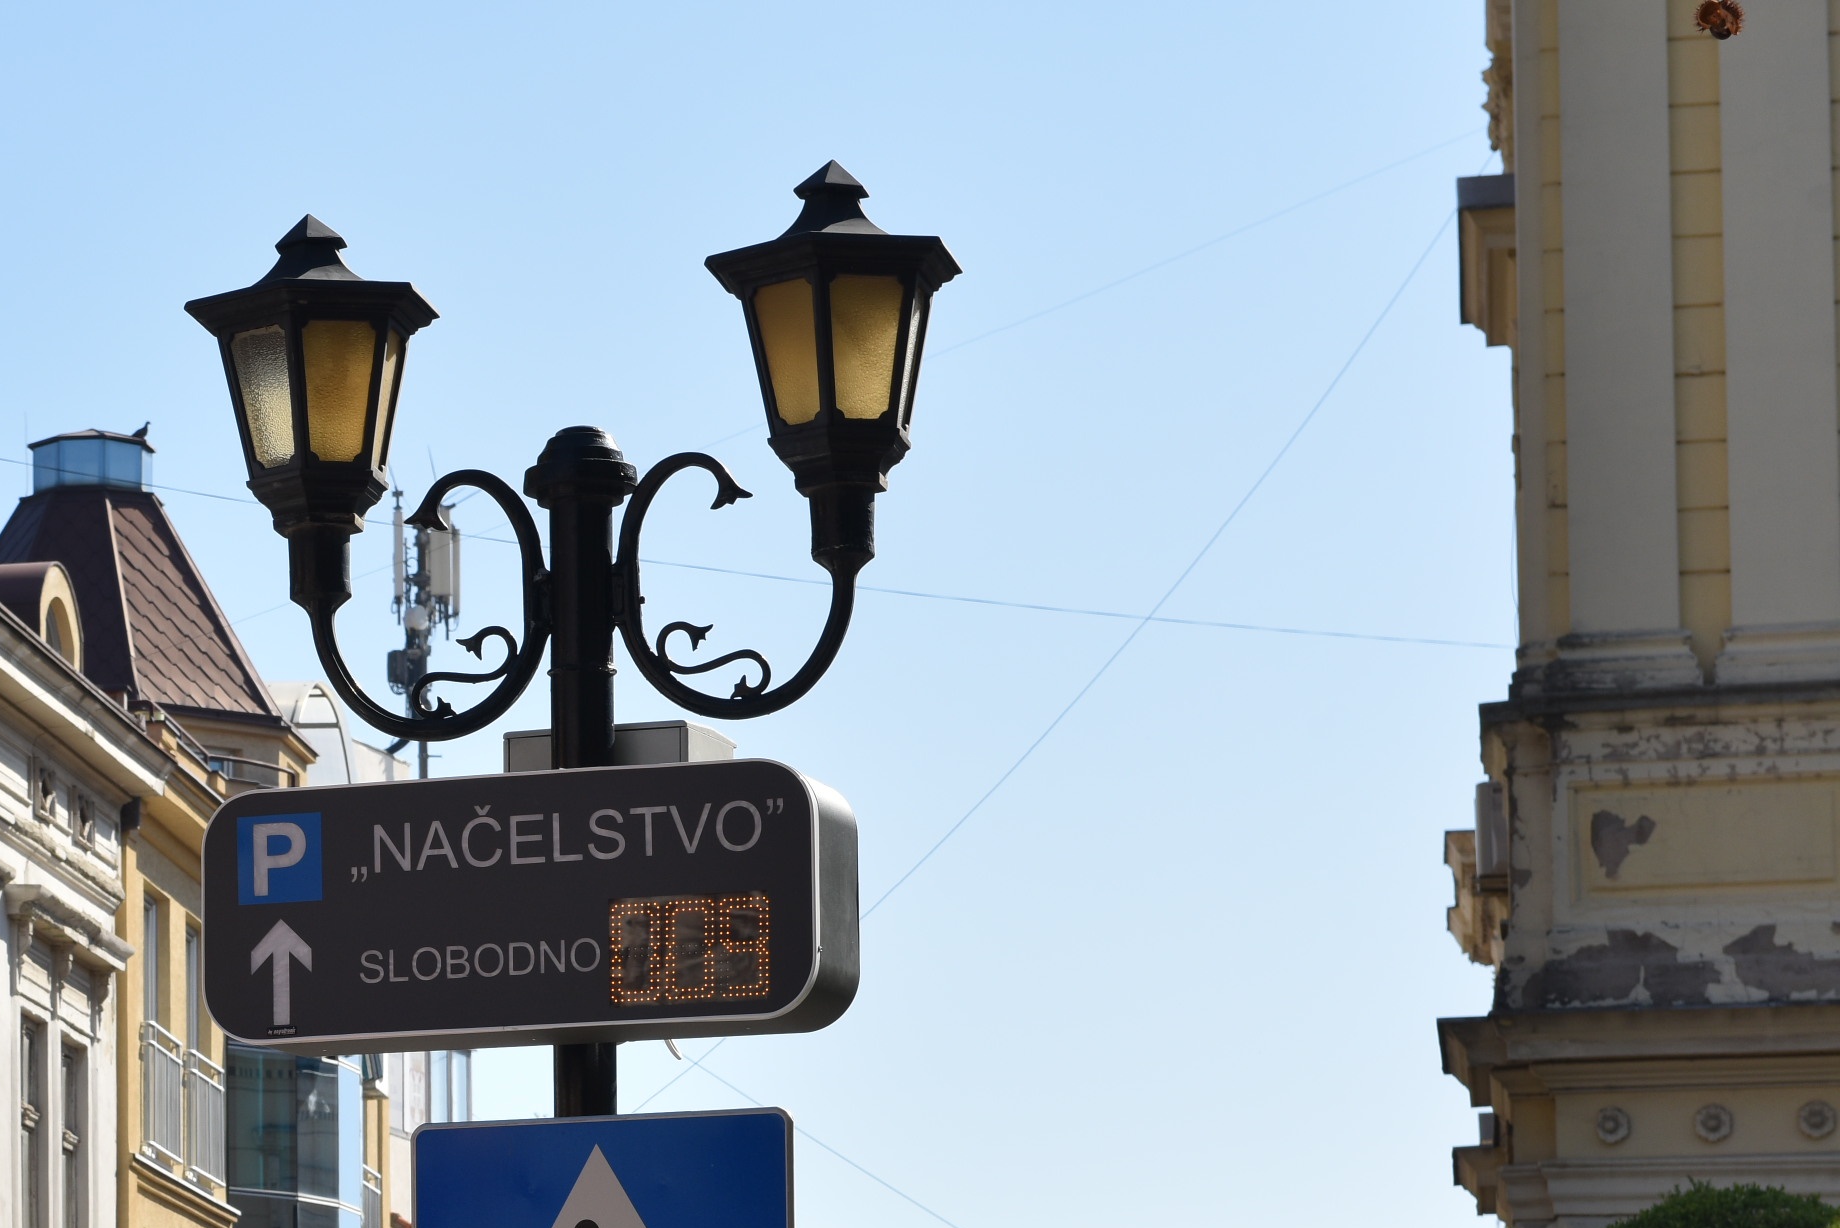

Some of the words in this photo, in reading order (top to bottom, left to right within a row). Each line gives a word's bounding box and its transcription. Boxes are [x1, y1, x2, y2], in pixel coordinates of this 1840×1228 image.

[253, 822, 307, 897] P
[359, 937, 601, 984] SLOBODNO
[610, 895, 770, 1003] 009
